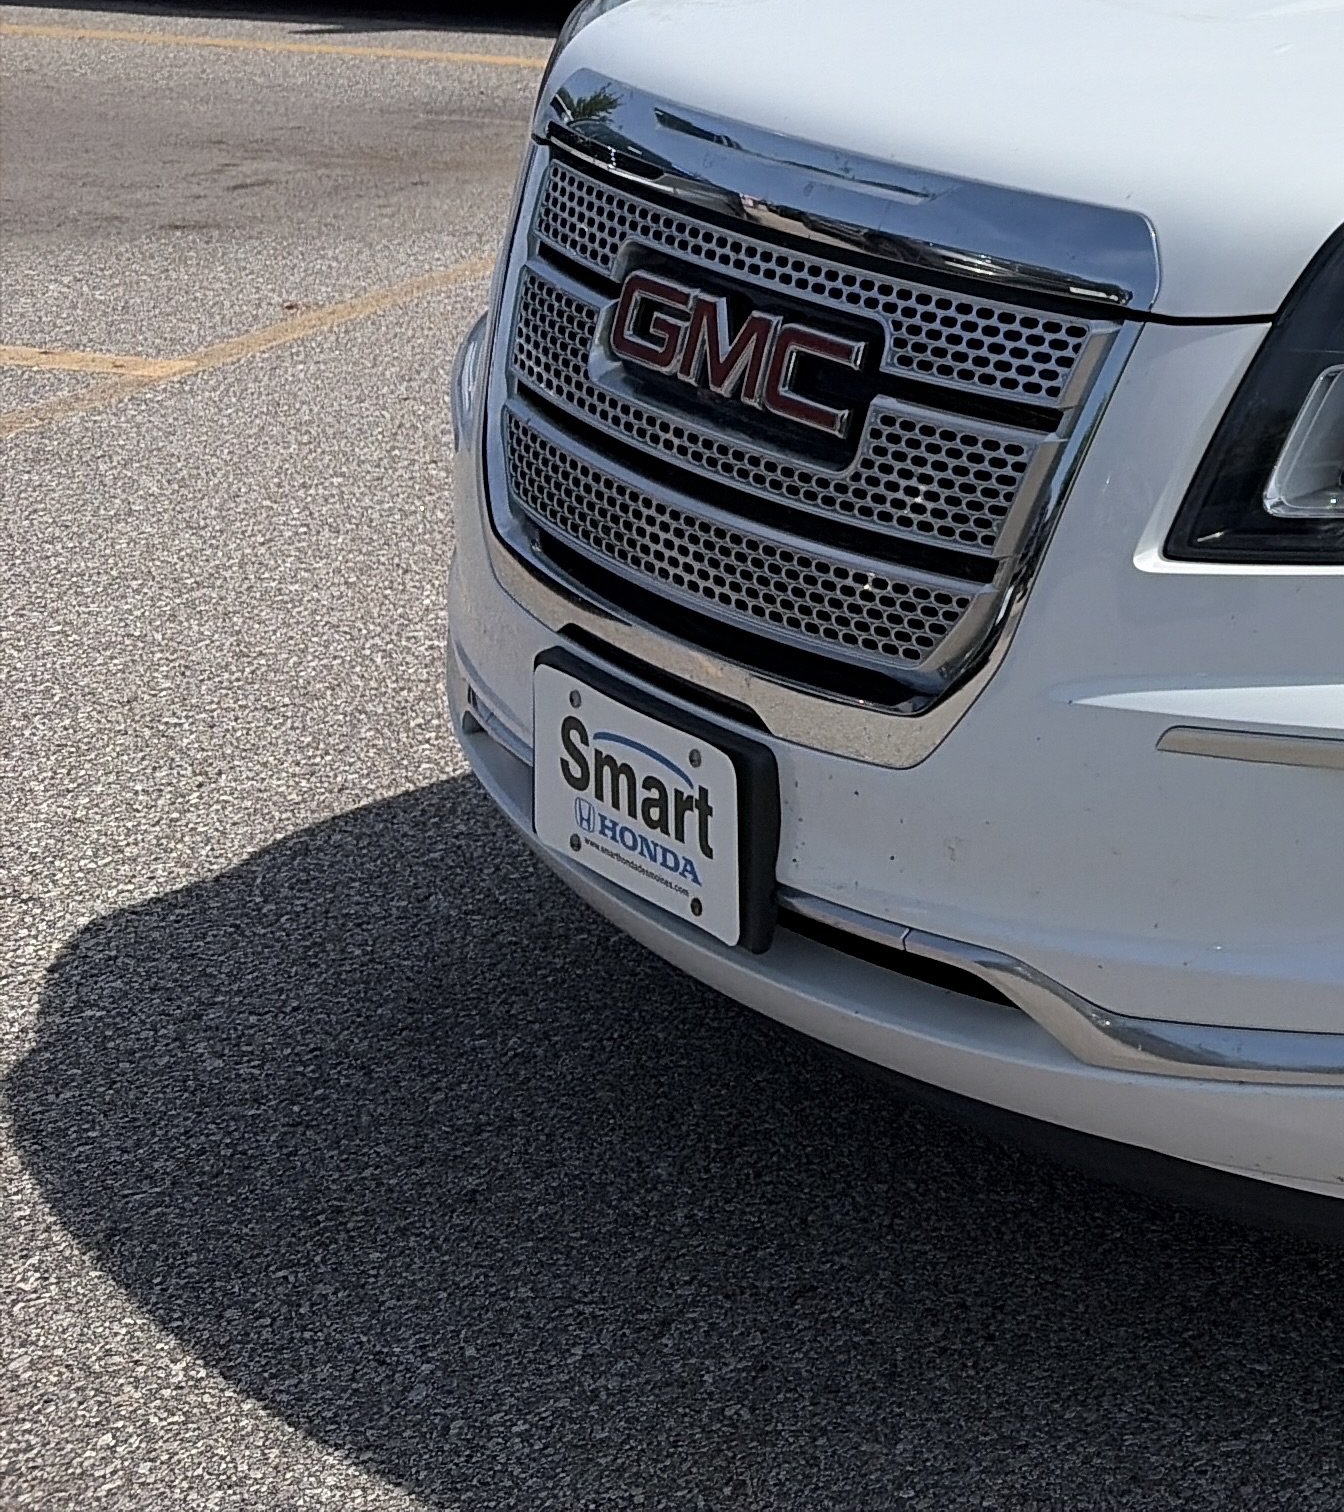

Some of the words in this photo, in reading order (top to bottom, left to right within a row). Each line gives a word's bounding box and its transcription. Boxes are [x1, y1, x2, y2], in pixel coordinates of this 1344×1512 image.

[611, 270, 866, 438] GMC
[560, 715, 714, 860] Smart
[599, 813, 703, 887] HONDA
